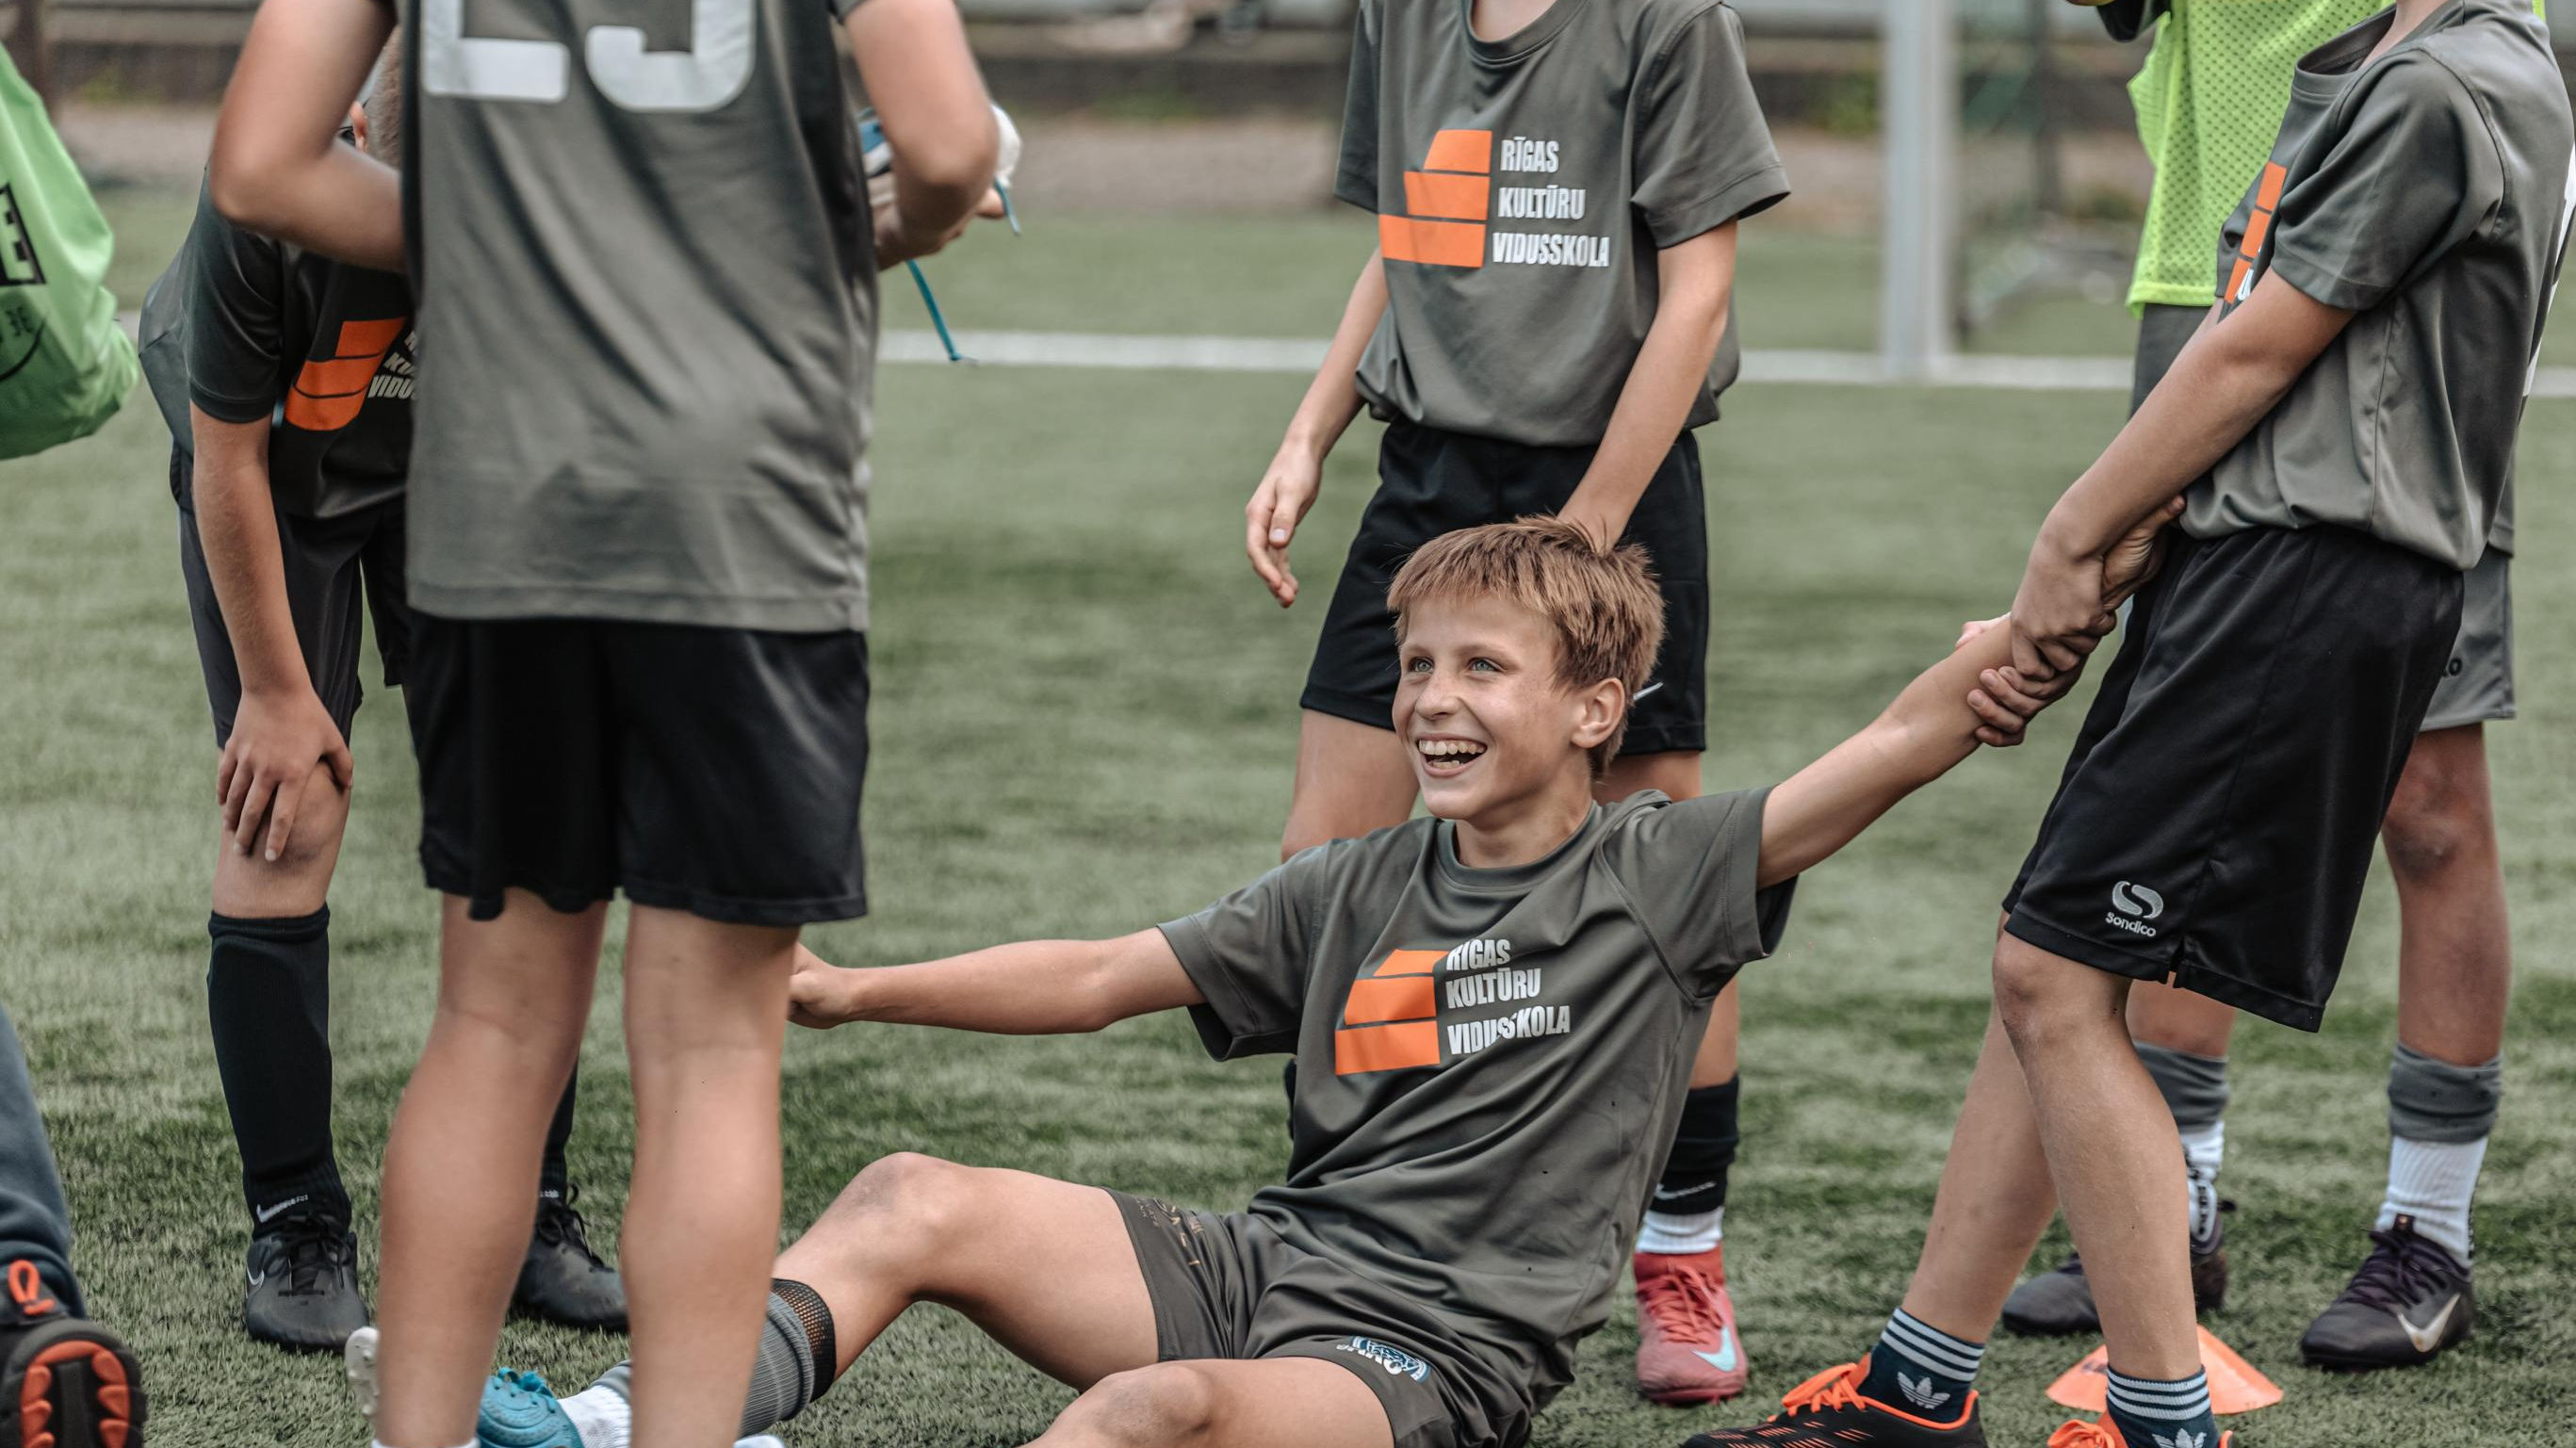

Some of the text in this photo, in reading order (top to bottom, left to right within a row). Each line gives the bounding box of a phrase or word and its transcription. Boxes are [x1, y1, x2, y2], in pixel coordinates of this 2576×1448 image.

[1500, 136, 1559, 172] RĪGAS
[1497, 185, 1586, 220] KULTŪRU
[1492, 233, 1610, 267] VIDUSSKOLA
[2105, 912, 2156, 936] Sondico
[1445, 968, 1541, 1009] KULTŪRU
